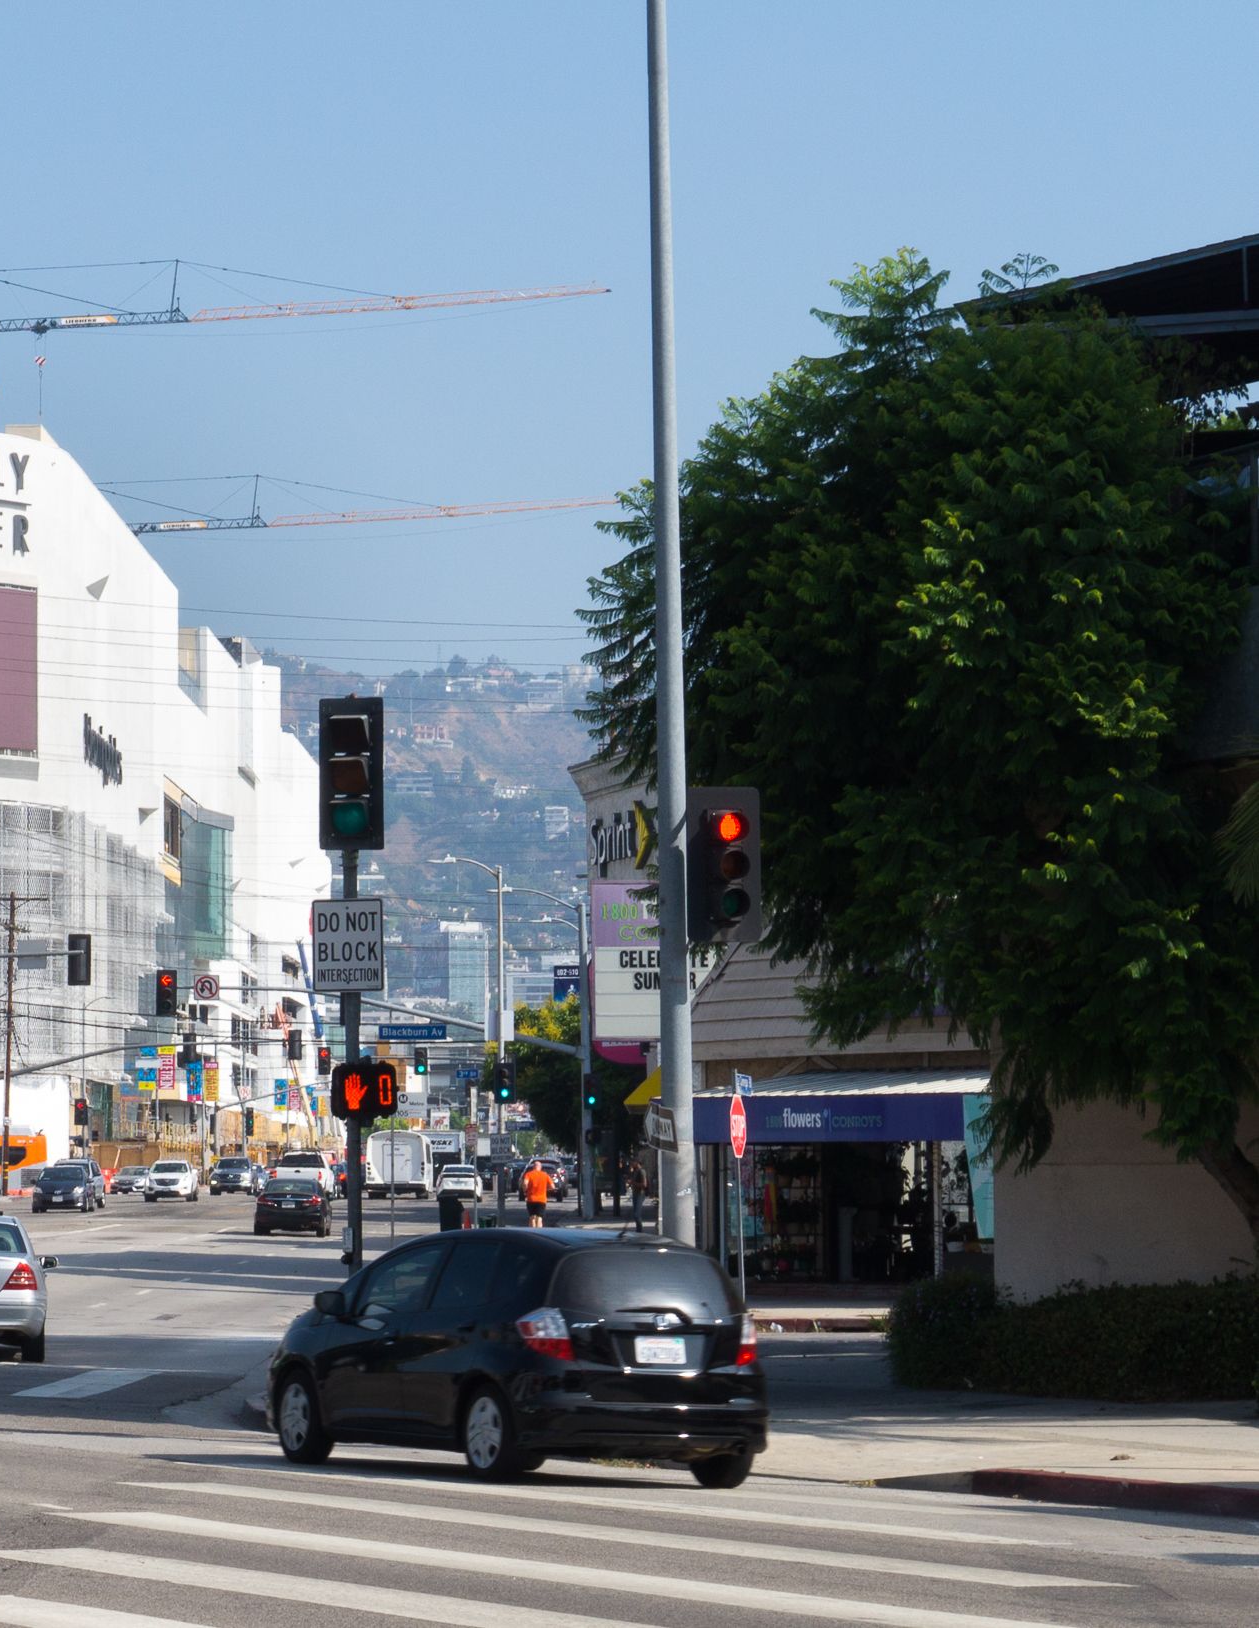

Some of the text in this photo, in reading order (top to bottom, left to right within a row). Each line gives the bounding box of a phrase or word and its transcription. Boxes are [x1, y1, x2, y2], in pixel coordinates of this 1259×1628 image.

[590, 811, 633, 878] Sprint
[317, 911, 378, 933] DO NOT
[602, 903, 638, 921] 1800
[317, 941, 378, 962] BLOCK
[317, 967, 379, 983] INTERSECTION
[382, 1027, 443, 1037] Blackburn Av
[160, 1054, 174, 1088] TELETHON
